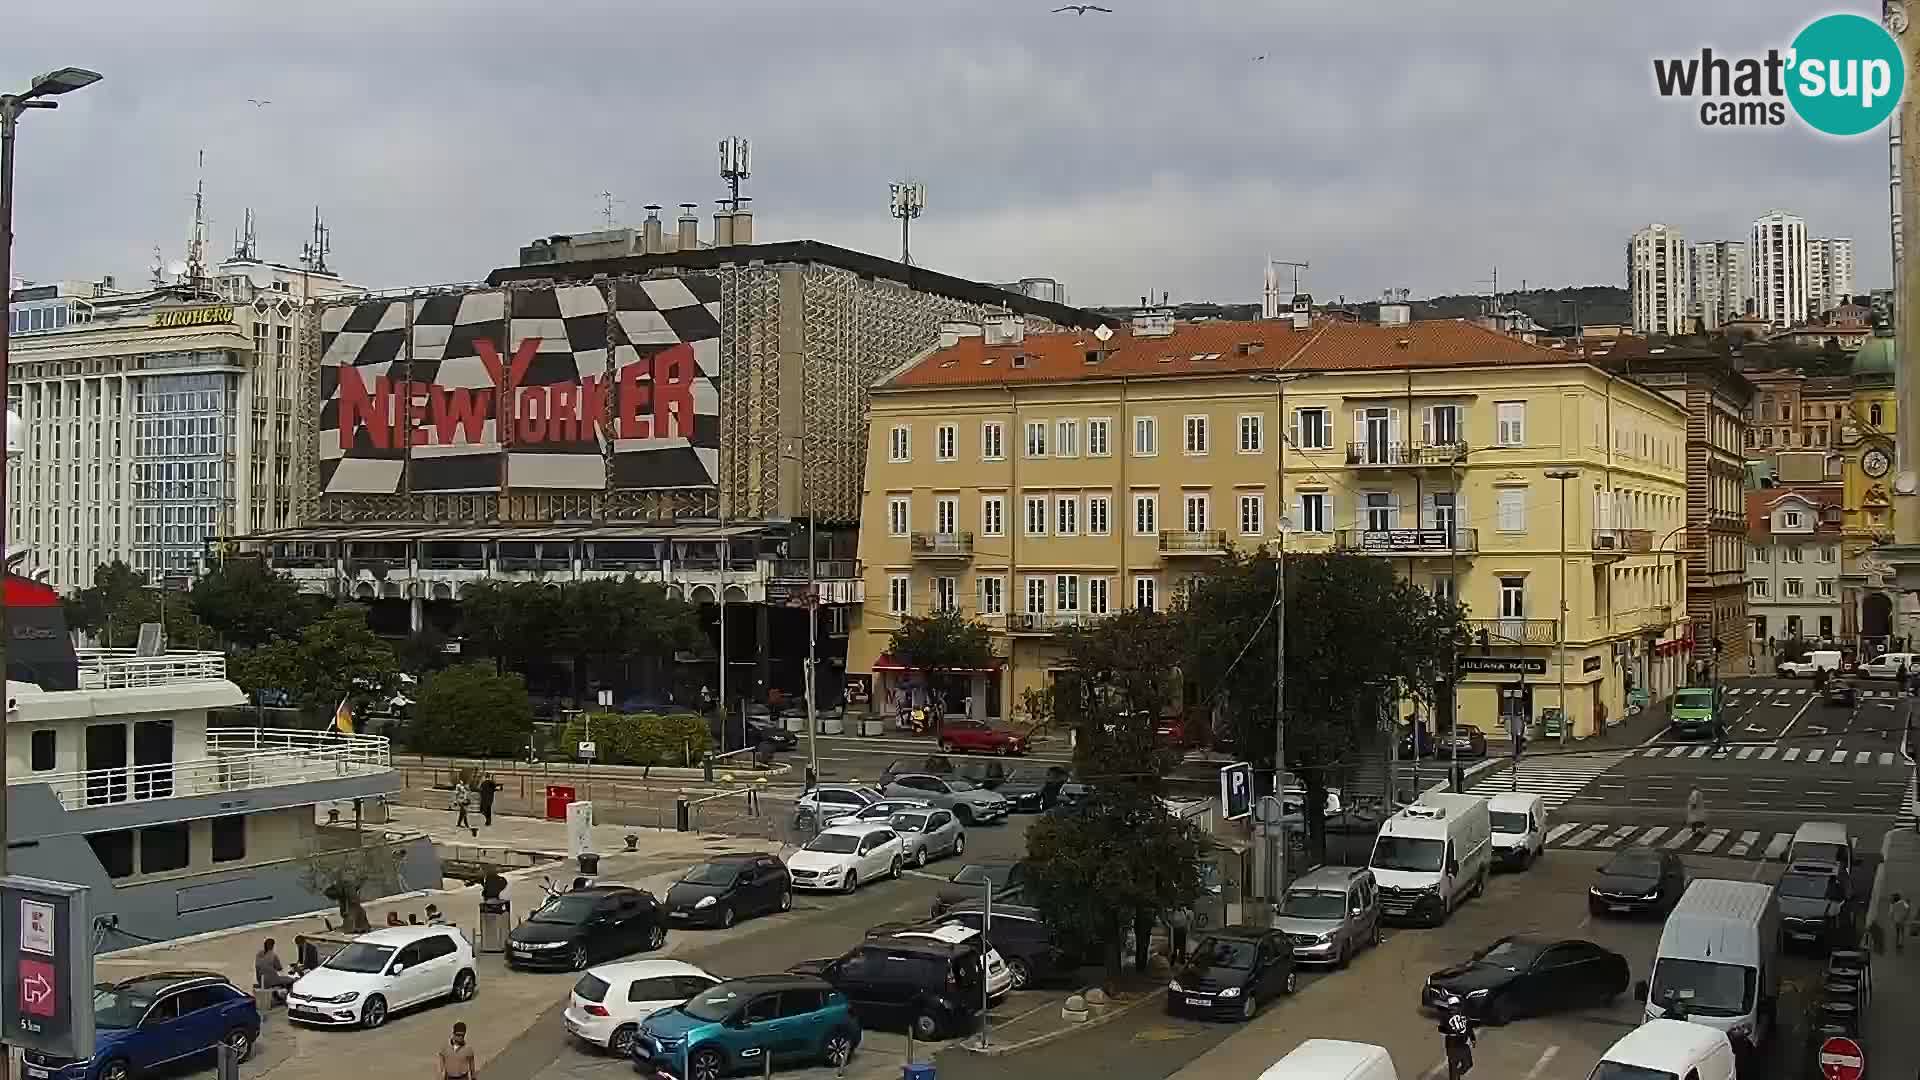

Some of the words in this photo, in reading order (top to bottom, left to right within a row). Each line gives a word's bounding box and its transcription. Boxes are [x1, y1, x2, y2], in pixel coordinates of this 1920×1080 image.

[1459, 661, 1505, 670] JULIANA
[1509, 662, 1541, 670] NAILS
[1232, 771, 1244, 795] P
